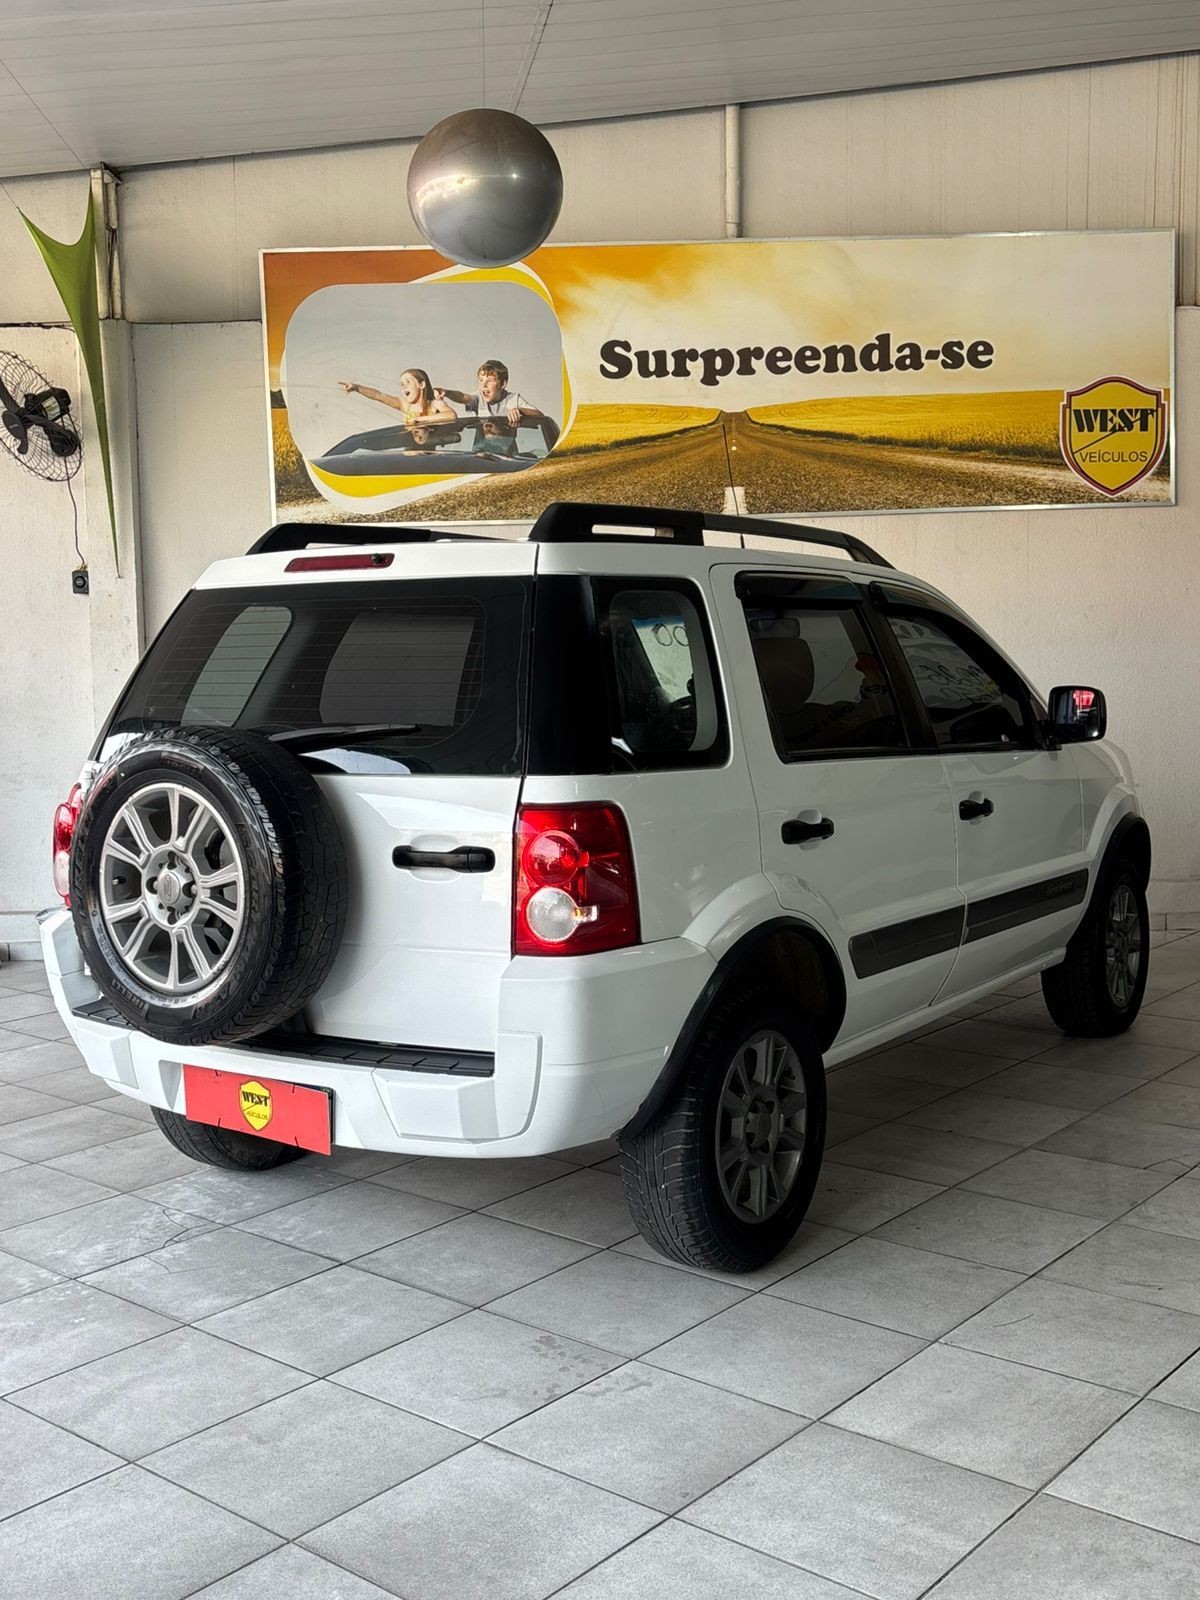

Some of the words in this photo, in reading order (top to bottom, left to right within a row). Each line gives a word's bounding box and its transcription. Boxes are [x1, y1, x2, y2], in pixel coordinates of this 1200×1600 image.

[599, 332, 994, 386] Surpreenda-se
[1073, 408, 1155, 432] WEST
[1080, 449, 1147, 462] VEÍCULOS
[241, 1091, 270, 1107] WEST
